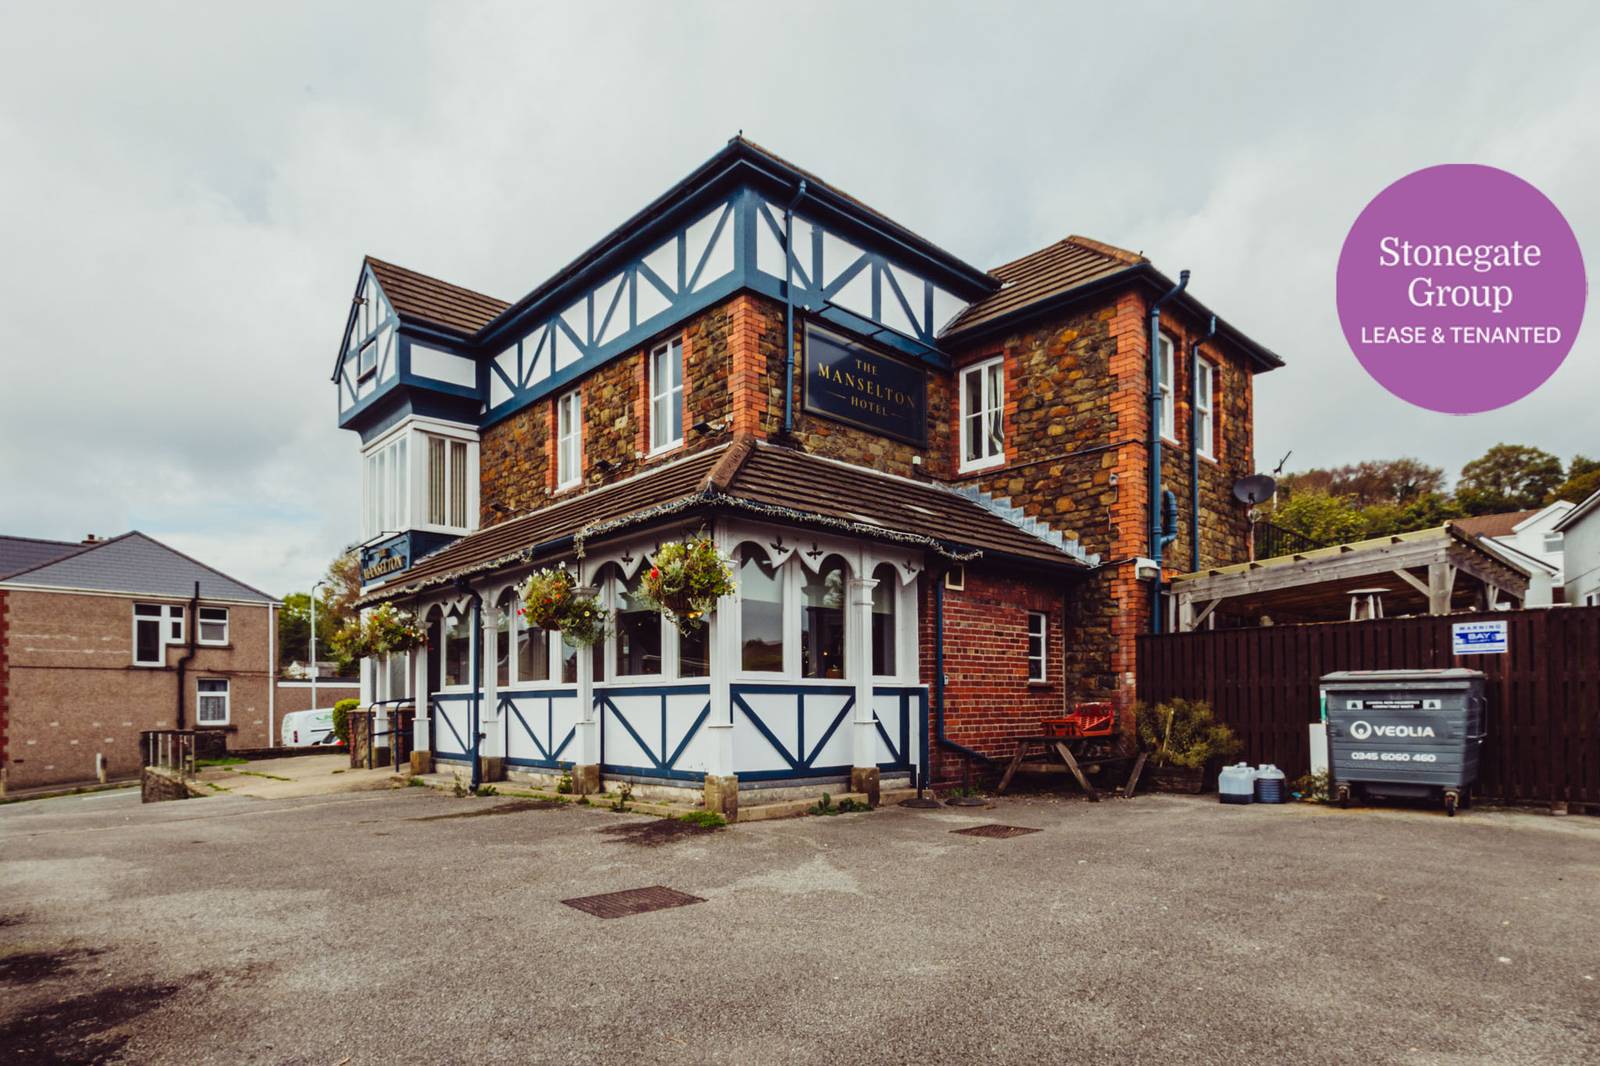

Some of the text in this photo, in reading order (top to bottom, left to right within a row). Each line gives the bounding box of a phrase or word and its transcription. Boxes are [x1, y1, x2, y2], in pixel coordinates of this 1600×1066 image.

[855, 359, 878, 376] THE
[817, 362, 915, 408] MANSELTON
[851, 395, 888, 416] HOTEL
[1373, 725, 1435, 737] VEOLIA
